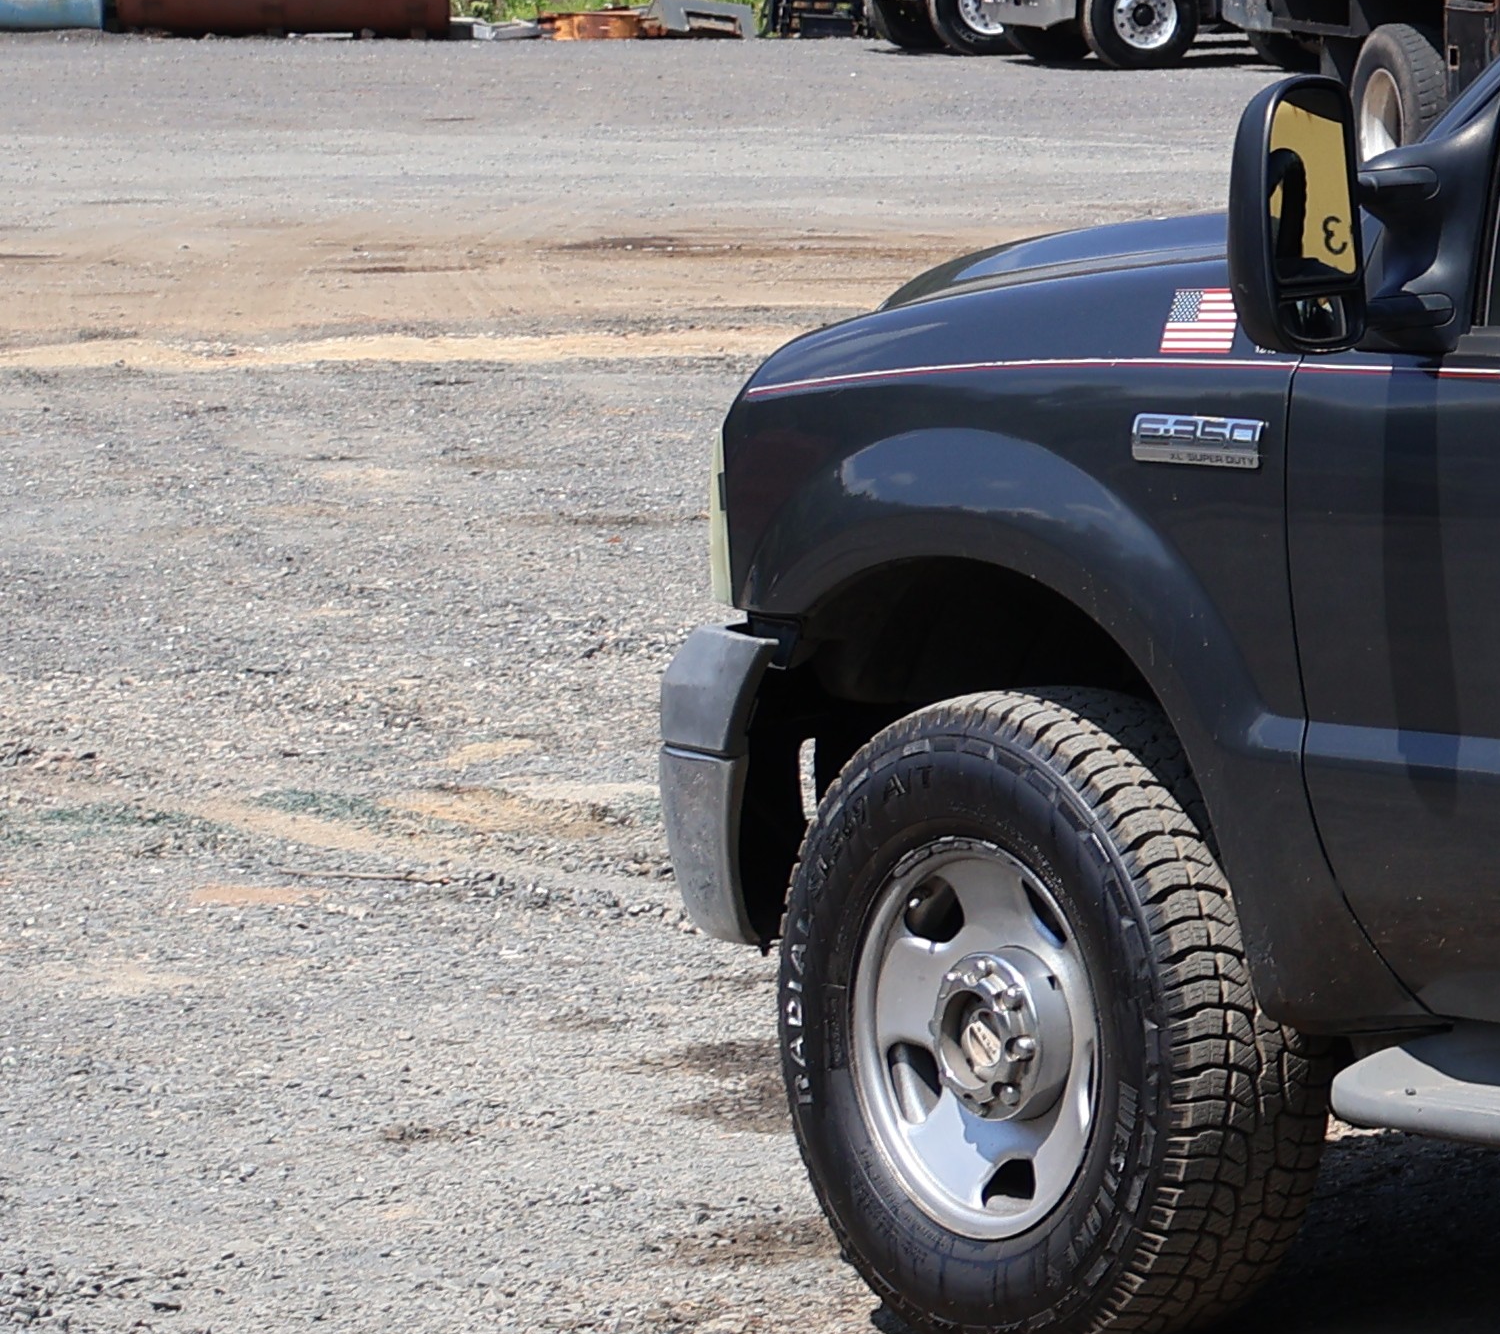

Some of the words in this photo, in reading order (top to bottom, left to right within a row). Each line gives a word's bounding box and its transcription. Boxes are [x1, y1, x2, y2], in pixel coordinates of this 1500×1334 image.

[1187, 453, 1224, 464] SUPER
[1225, 455, 1254, 466] DUTY
[882, 764, 934, 799] A/T
